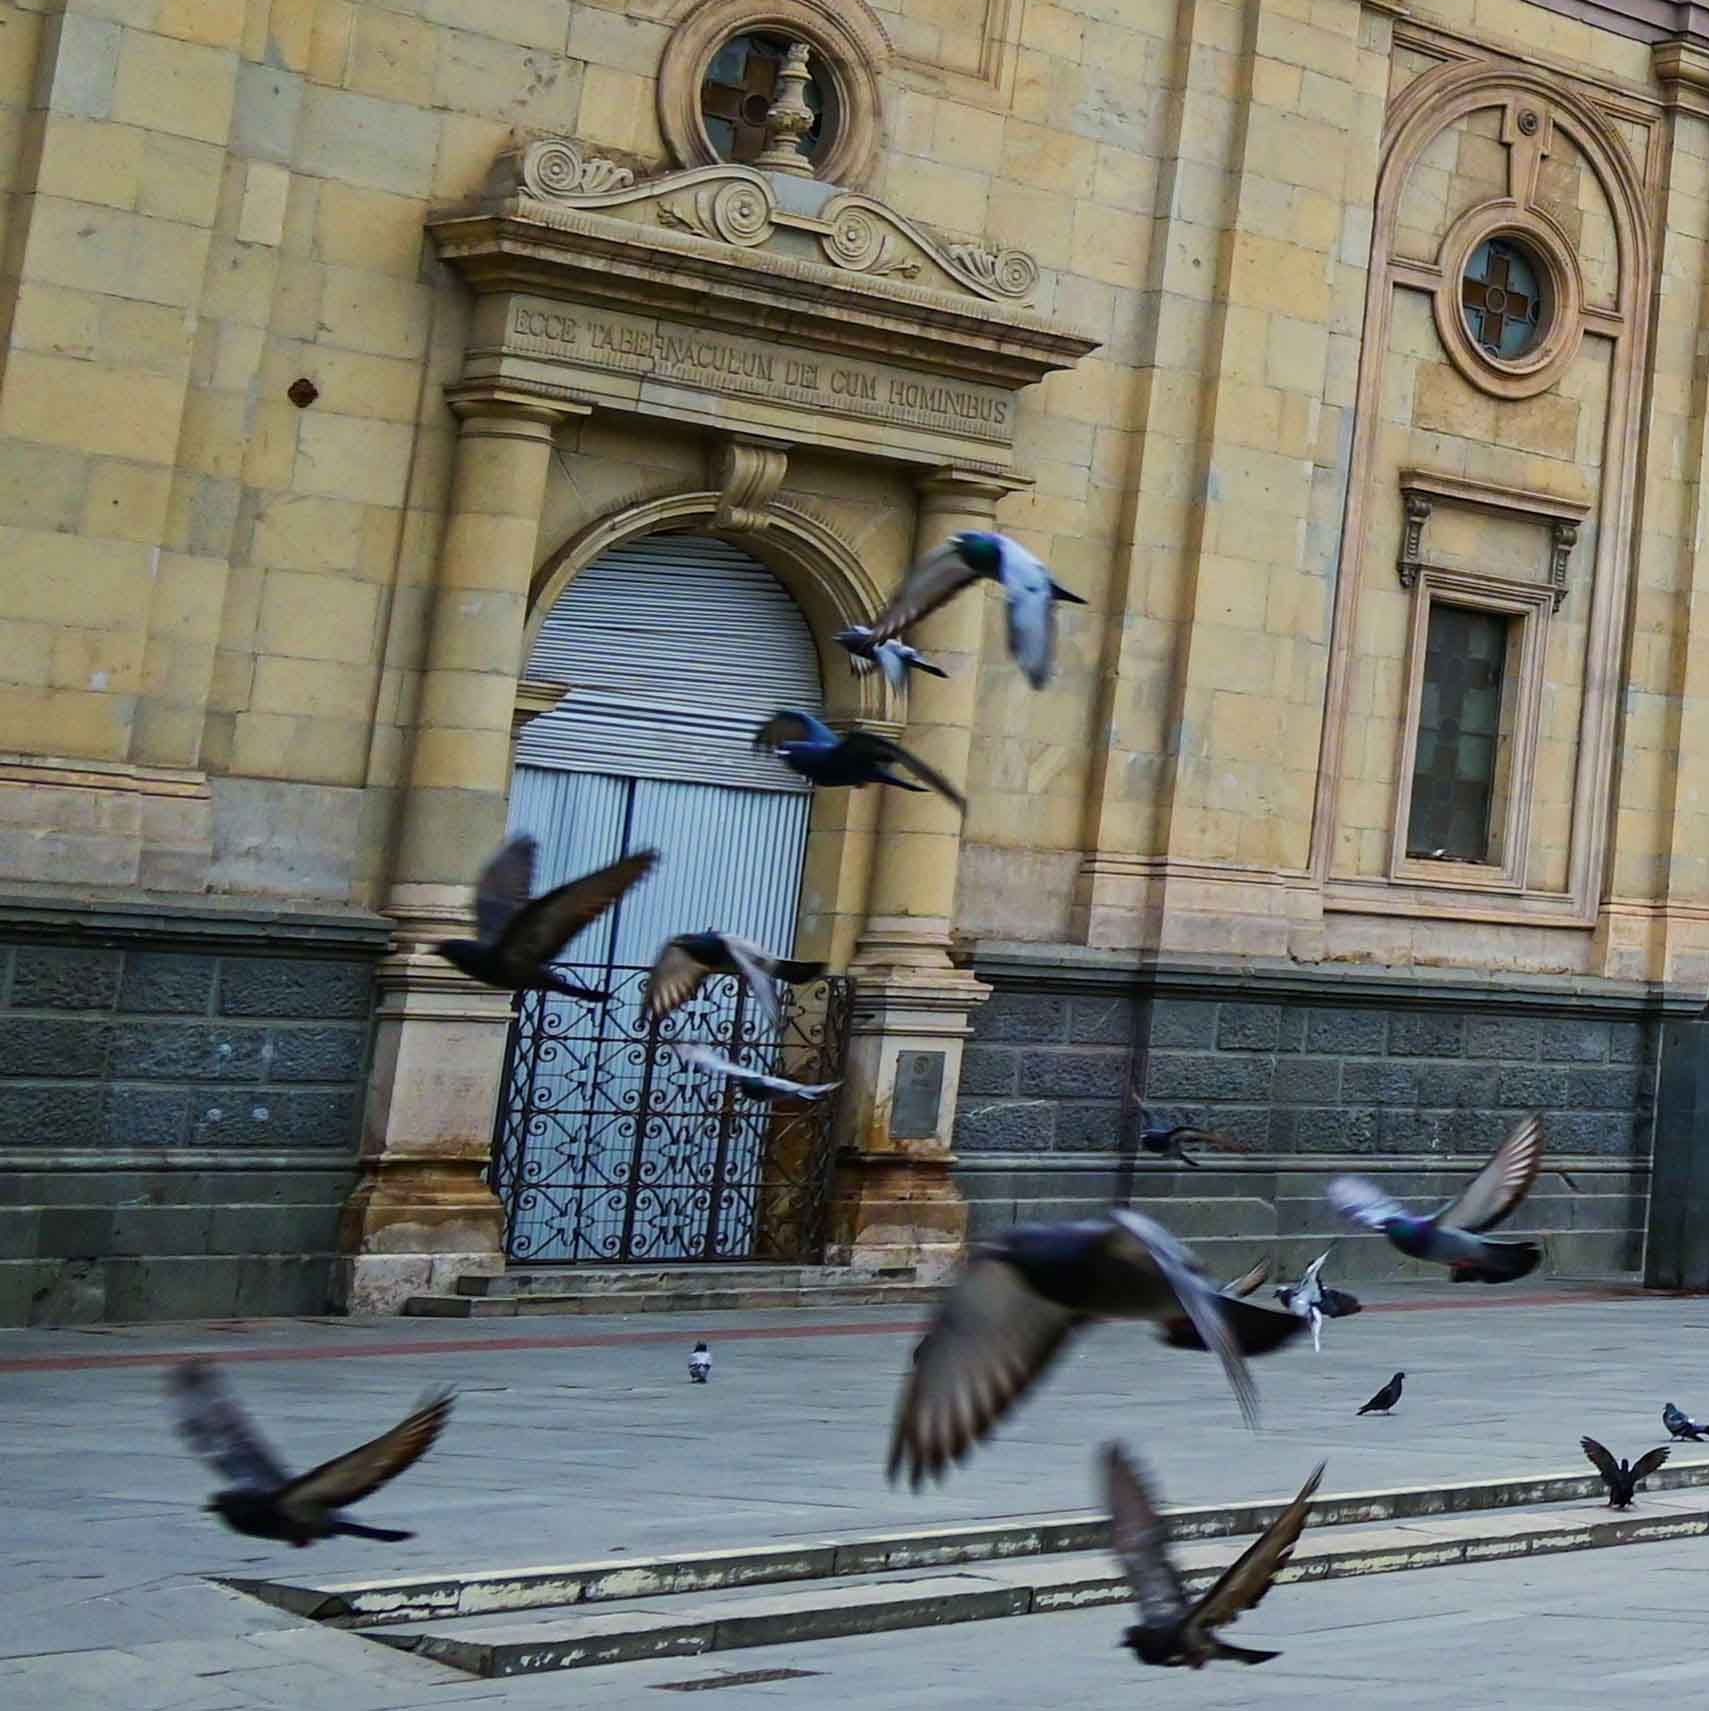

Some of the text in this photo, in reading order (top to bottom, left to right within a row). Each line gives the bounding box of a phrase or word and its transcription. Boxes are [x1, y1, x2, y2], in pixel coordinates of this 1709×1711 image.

[513, 307, 1009, 425] ECCE TABERNACULUM DEI CUM HOMINIBUS
